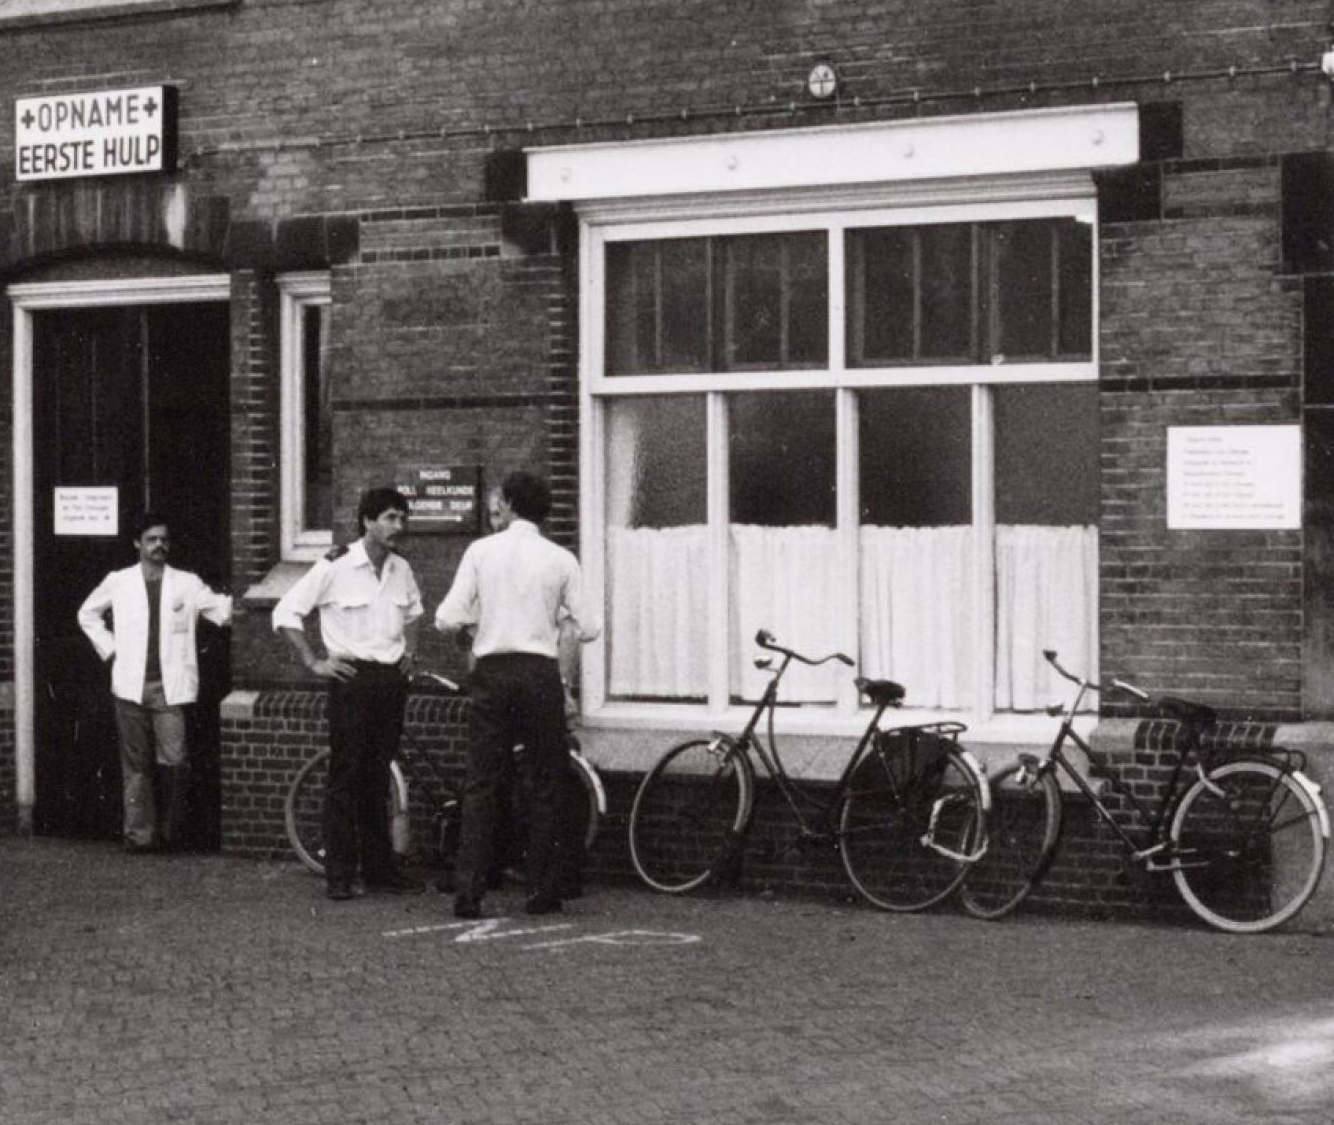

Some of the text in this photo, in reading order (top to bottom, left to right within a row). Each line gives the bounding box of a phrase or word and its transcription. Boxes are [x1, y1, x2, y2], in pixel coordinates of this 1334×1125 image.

[38, 94, 140, 132] OPNAME
[19, 133, 160, 174] EERSTE HULP
